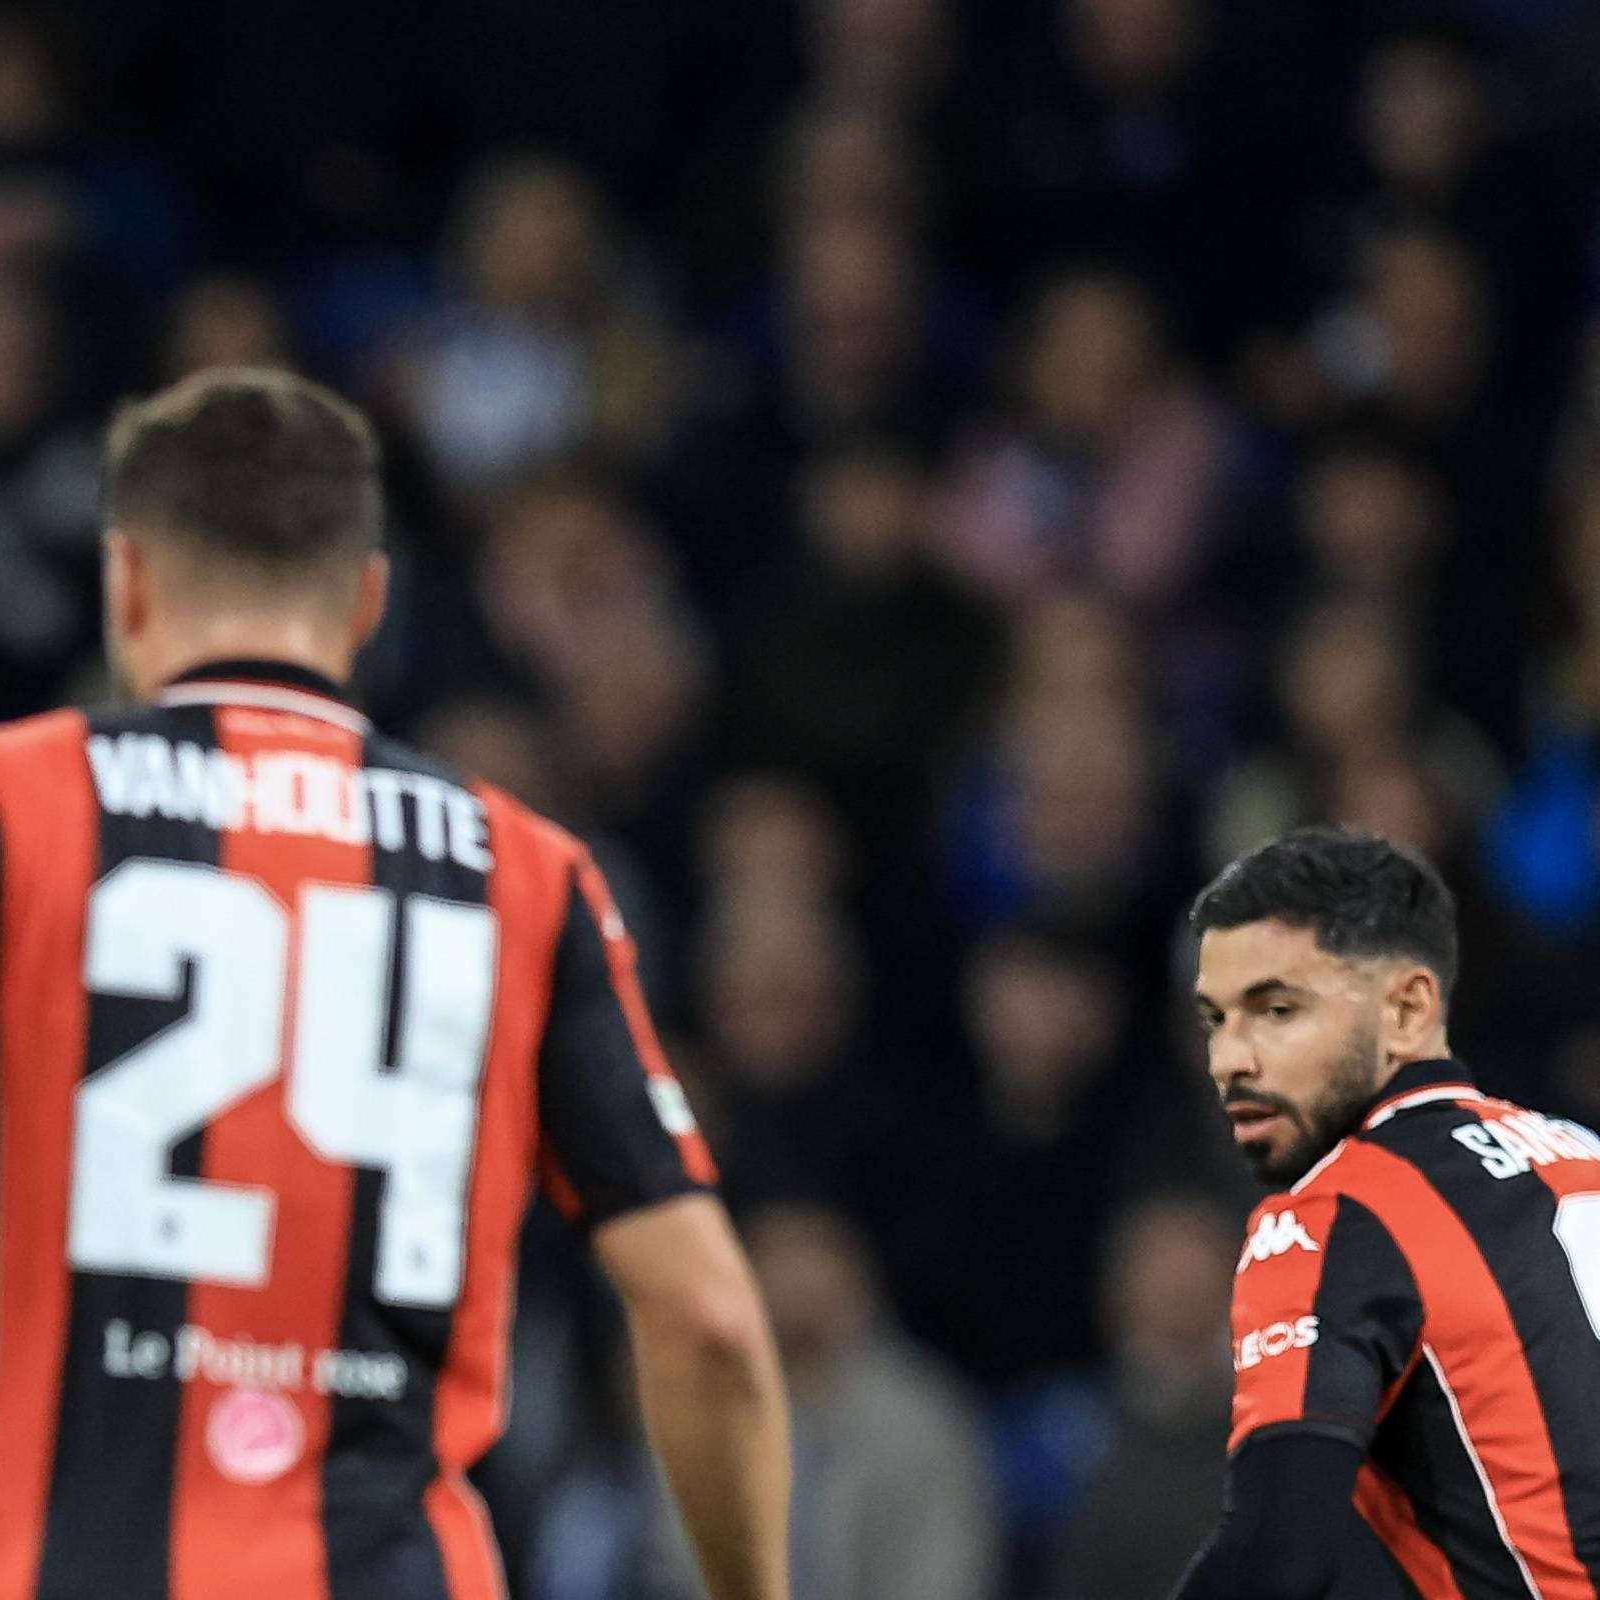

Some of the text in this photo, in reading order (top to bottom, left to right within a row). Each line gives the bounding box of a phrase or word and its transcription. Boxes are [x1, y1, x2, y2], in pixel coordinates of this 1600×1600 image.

[87, 731, 494, 874] VANHOUTTE
[67, 856, 498, 1310] 24
[103, 1318, 171, 1380] Le
[174, 1323, 305, 1387] Point
